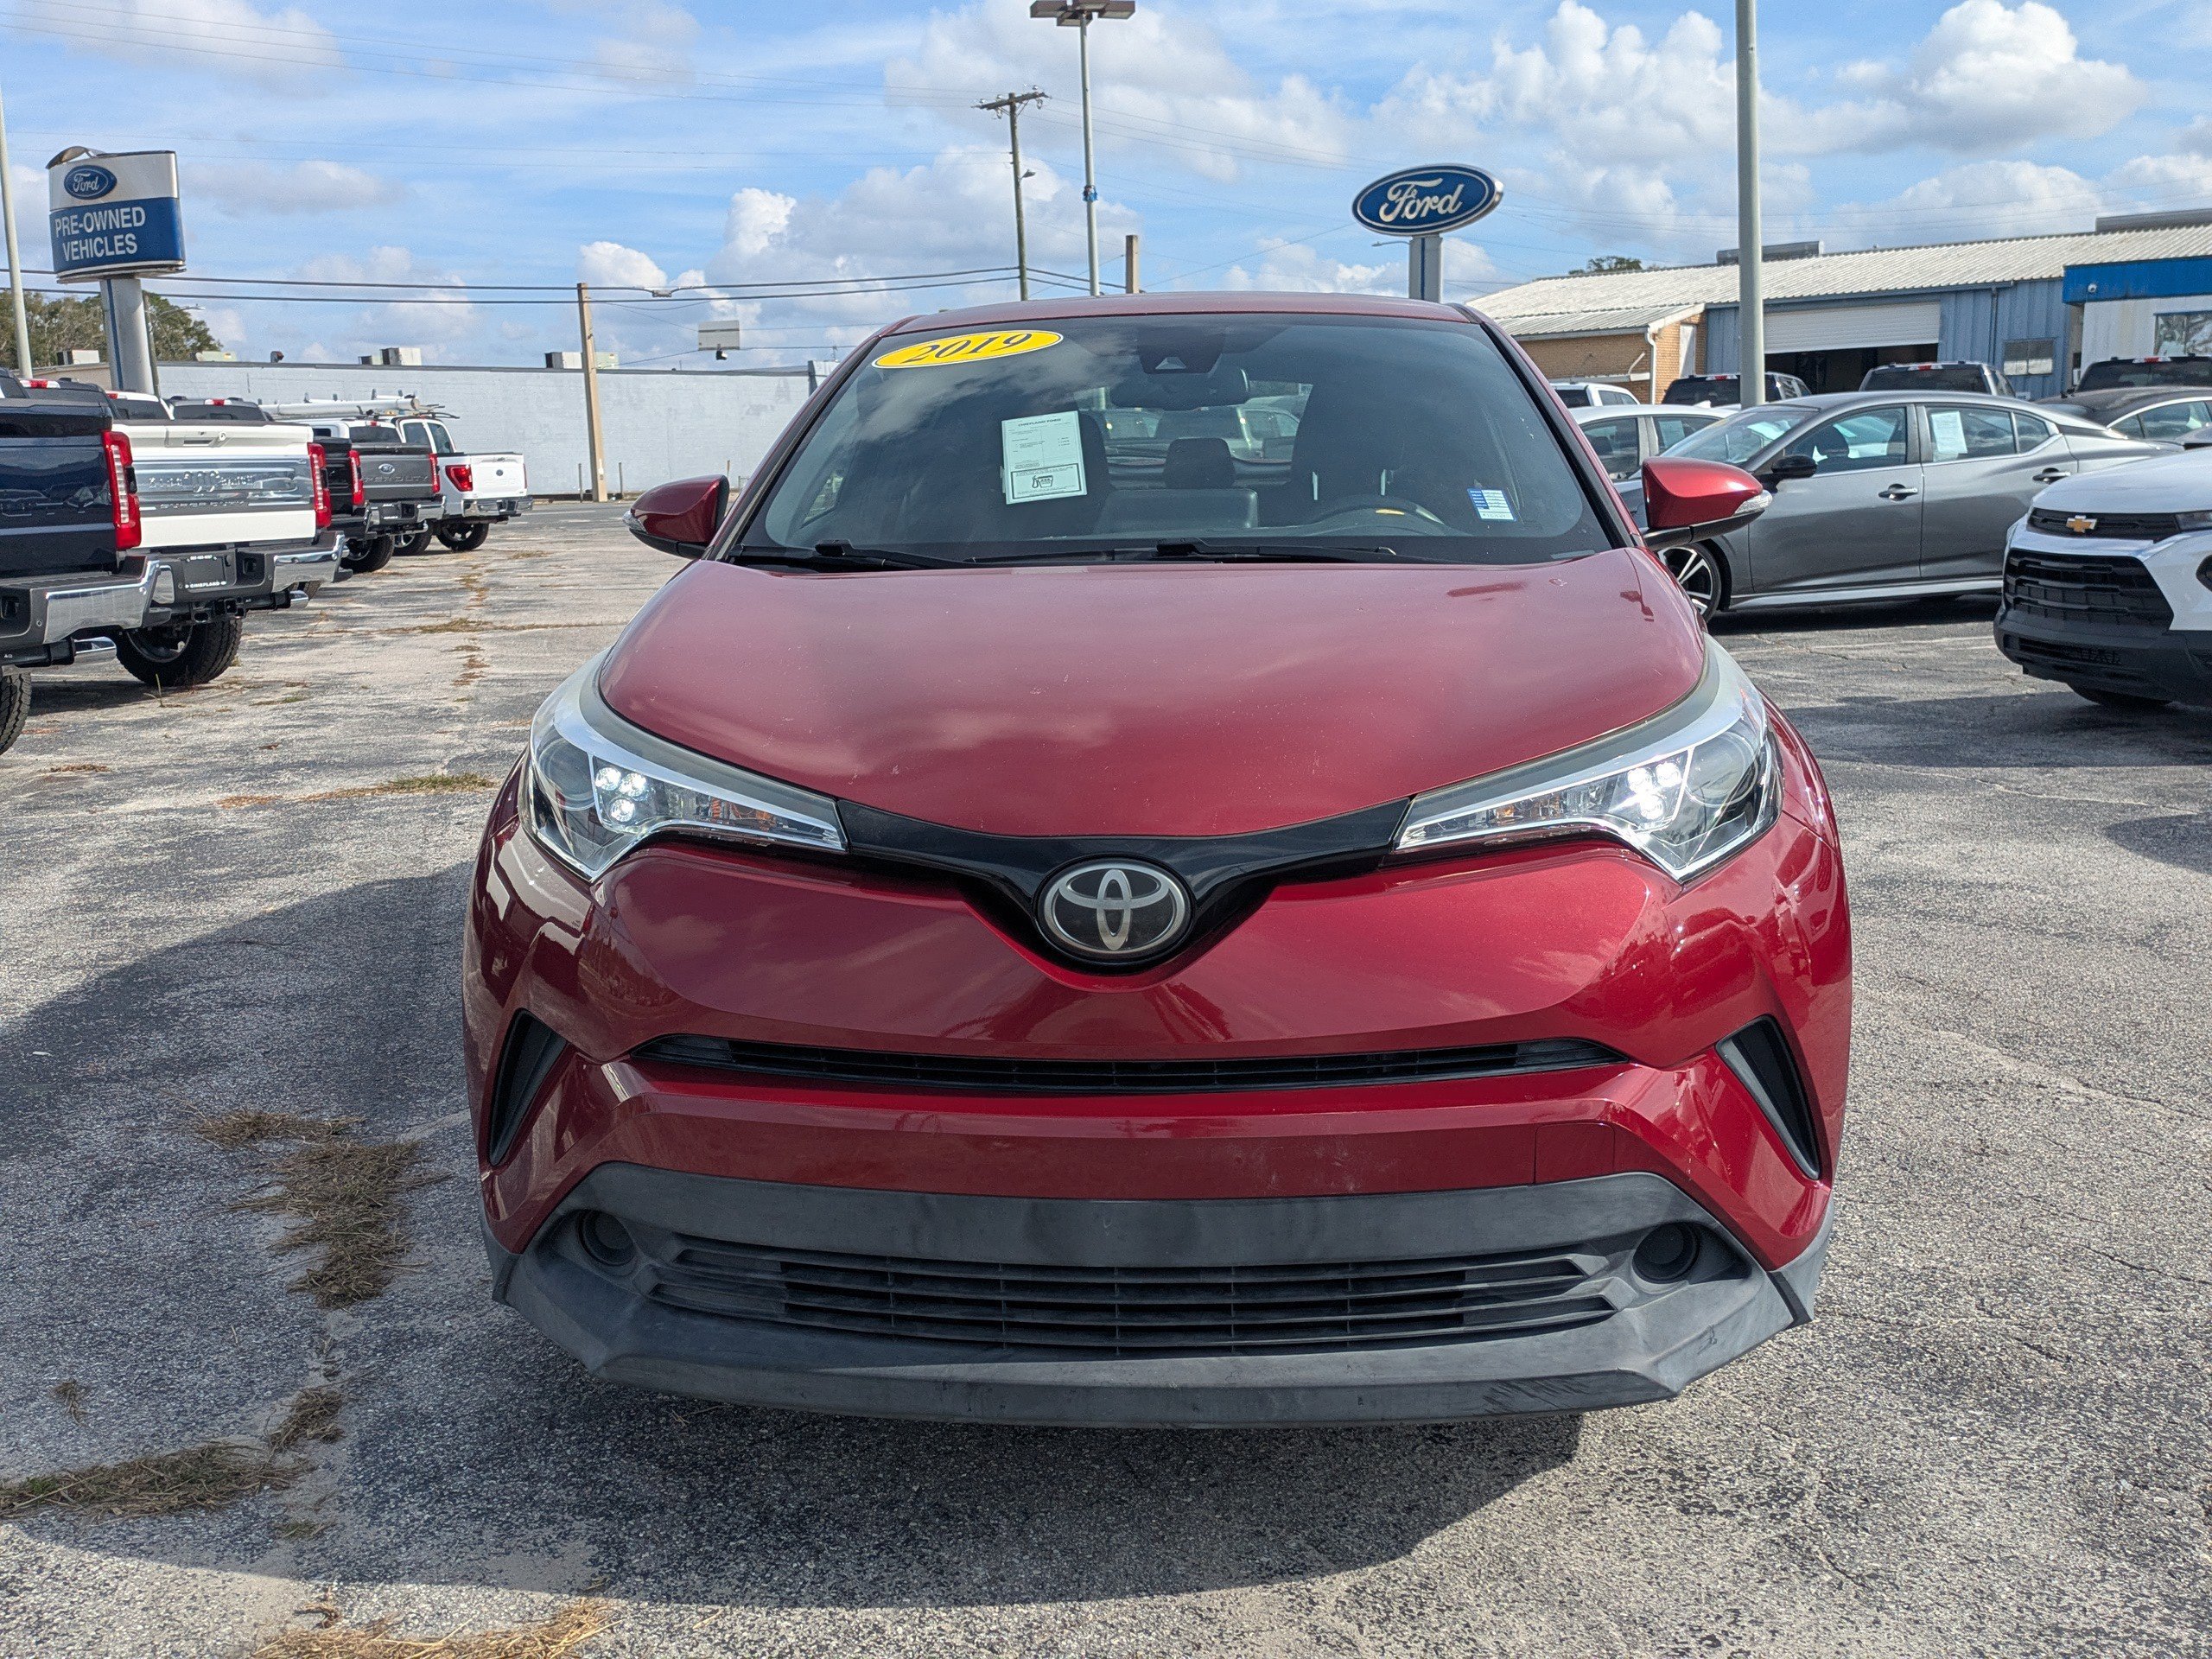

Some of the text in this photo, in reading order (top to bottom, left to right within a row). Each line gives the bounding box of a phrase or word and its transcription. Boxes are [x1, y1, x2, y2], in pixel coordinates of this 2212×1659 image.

[73, 173, 99, 193] Ford
[1379, 178, 1464, 222] Ford
[54, 206, 146, 238] PRE-OWNED
[62, 232, 138, 262] VEHICLES
[899, 333, 1032, 364] 2019
